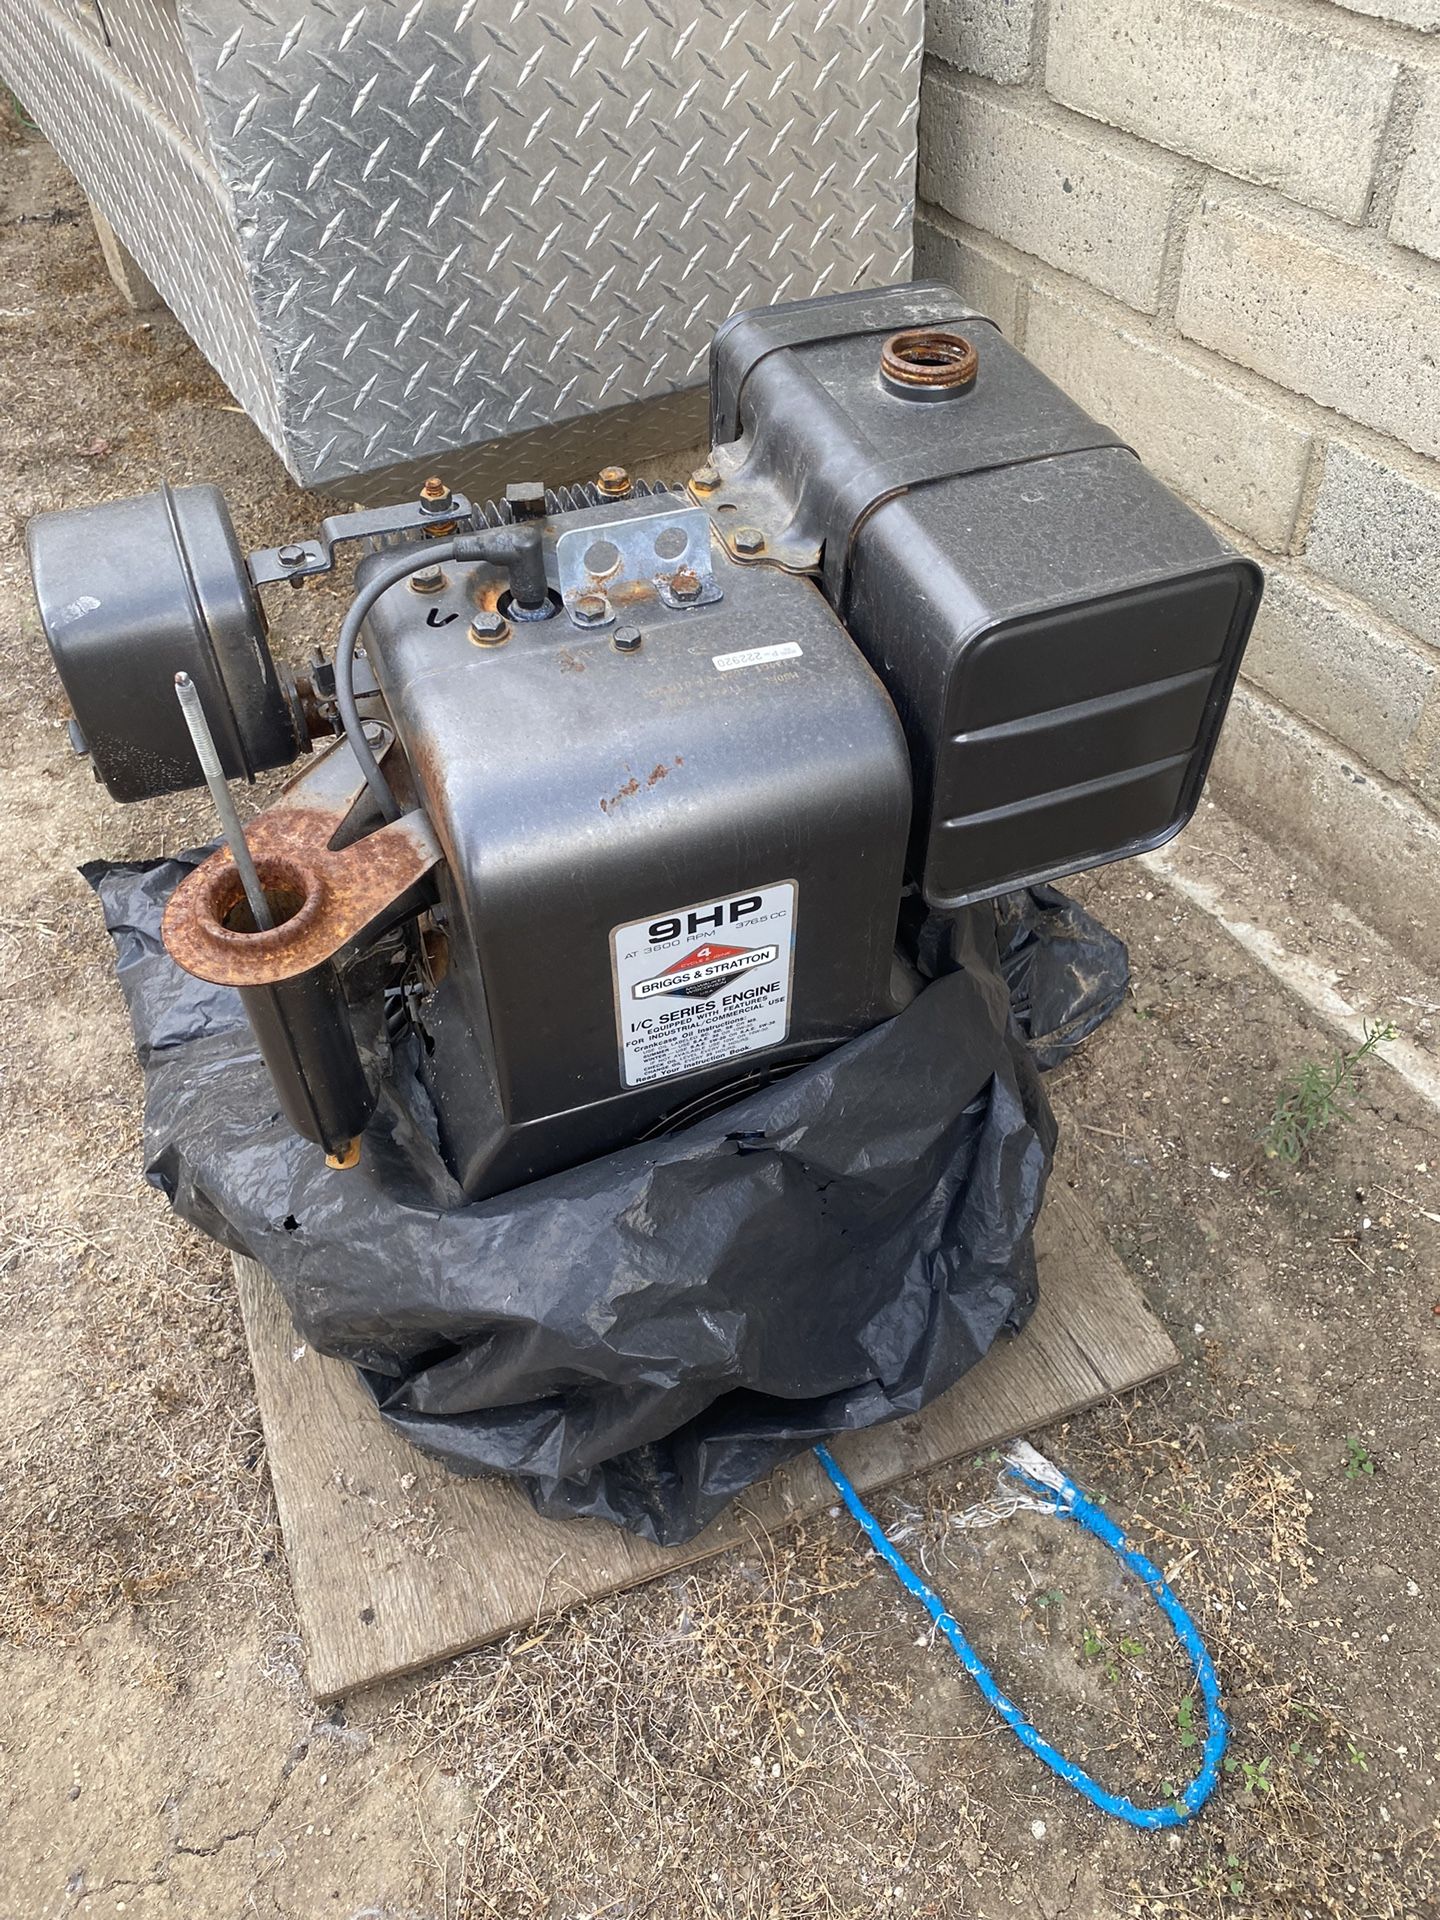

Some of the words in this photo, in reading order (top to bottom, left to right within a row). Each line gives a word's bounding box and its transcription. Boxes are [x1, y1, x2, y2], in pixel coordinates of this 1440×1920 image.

[624, 951, 638, 960] AT
[644, 939, 680, 954] 3600
[687, 929, 715, 943] RPM
[770, 910, 786, 920] CC
[697, 947, 711, 959] 4
[642, 973, 690, 994] BRIGGS
[694, 970, 702, 979] &
[705, 951, 769, 976] STRATTON
[626, 1038, 644, 1047] FOR
[649, 1003, 764, 1041] INDUSTRIAL/COMMERCIAL
[768, 996, 785, 1006] USE
[631, 1018, 653, 1033] I/C
[659, 1000, 715, 1024] SERIES
[723, 981, 780, 1006] ENGINE
[648, 1017, 692, 1034] EQUIPPED
[697, 1009, 719, 1020] WITH
[724, 995, 767, 1012] FEATURES
[634, 1036, 677, 1053] Crankcase
[698, 1016, 746, 1034] Instructions:
[671, 1035, 697, 1046] LABELED
[636, 1073, 656, 1083] Read
[662, 1067, 679, 1075] Your
[684, 1053, 725, 1068] Instruction
[730, 1045, 751, 1055] Book.
[643, 1048, 669, 1059] SUMMER
[644, 1053, 666, 1063] WINTER
[644, 1063, 663, 1071] CHECK
[680, 1053, 697, 1061] LEVEL
[701, 1046, 719, 1054] EVERY
[644, 1066, 669, 1076] CHANGE
[685, 1055, 703, 1063] EVERY
[674, 1046, 705, 1058] AVAILABLE
